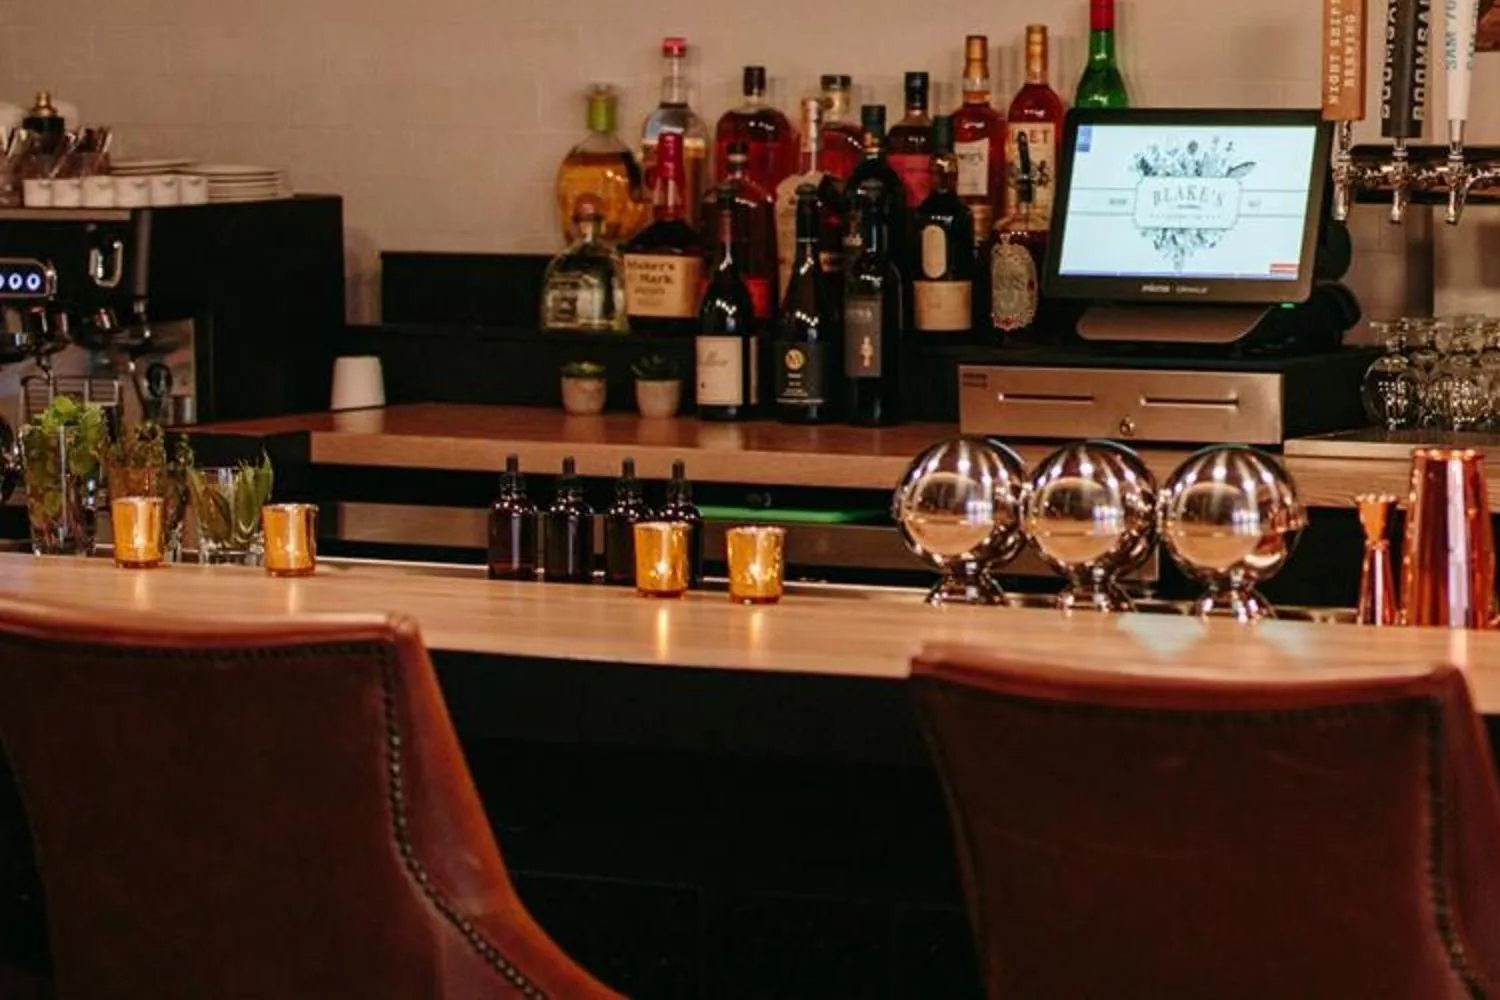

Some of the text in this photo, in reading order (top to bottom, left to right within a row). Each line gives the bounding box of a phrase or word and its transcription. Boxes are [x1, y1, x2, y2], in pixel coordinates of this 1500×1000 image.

[1343, 13, 1357, 88] BREWING
[1328, 55, 1342, 105] NIGHT
[639, 273, 673, 284] Mark
